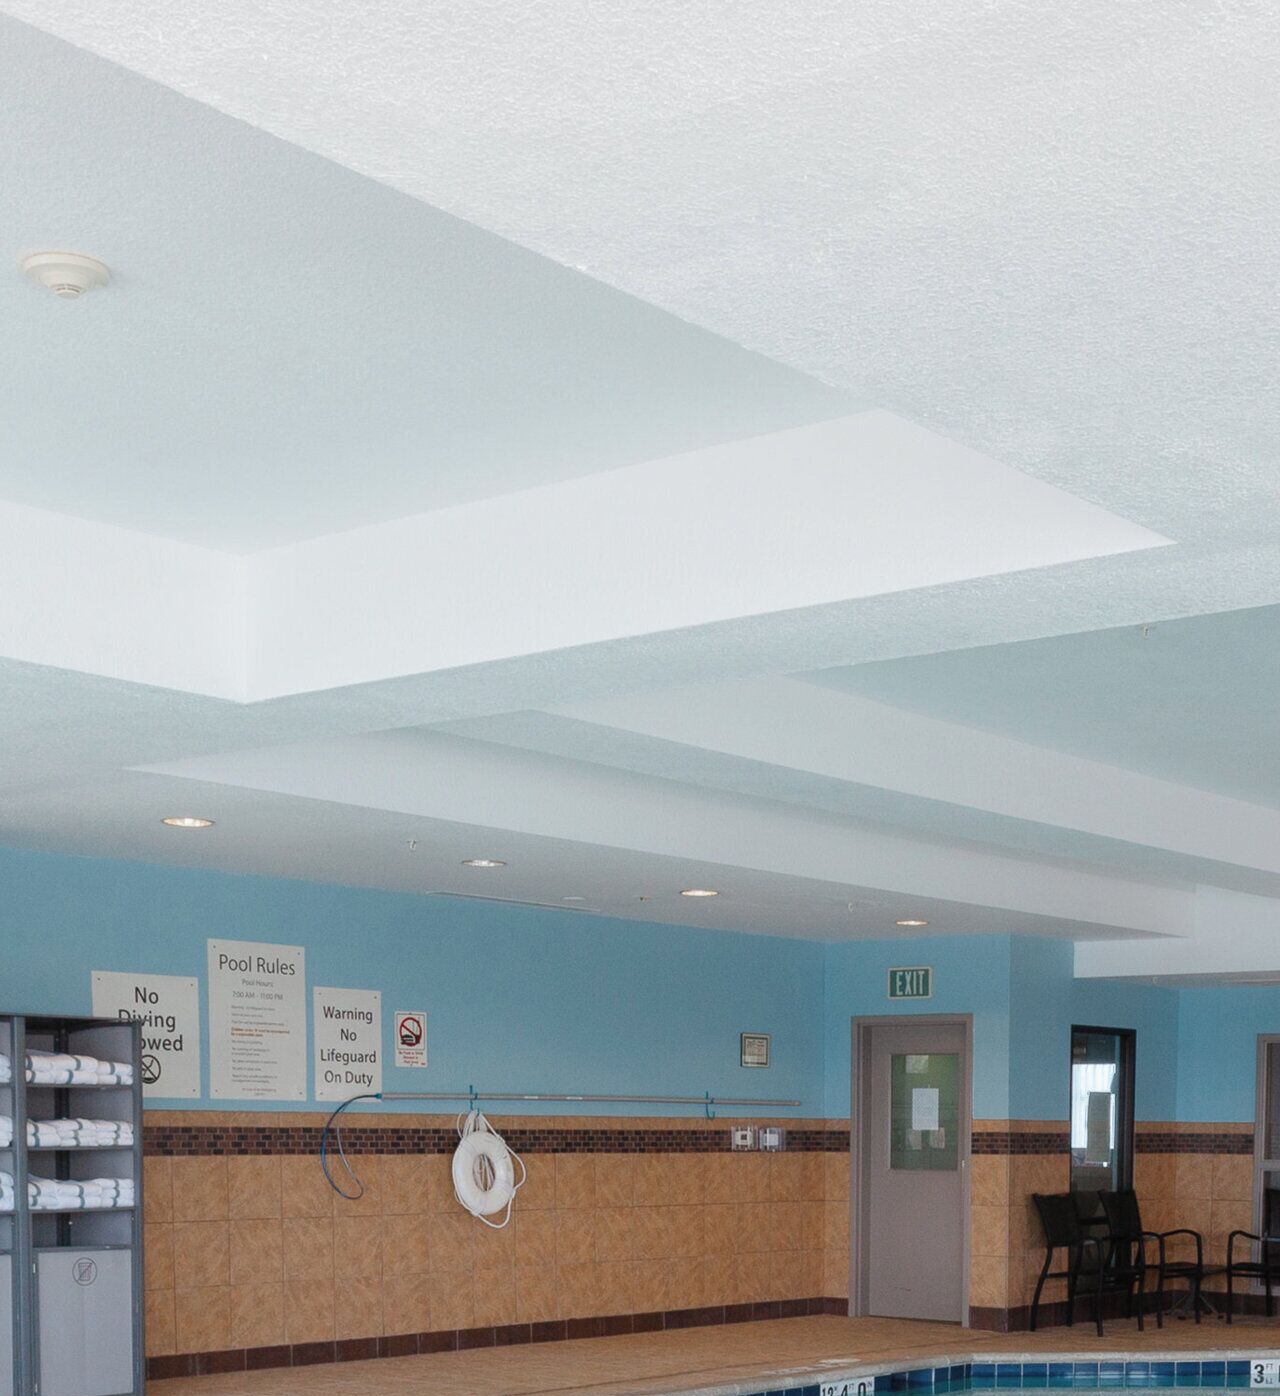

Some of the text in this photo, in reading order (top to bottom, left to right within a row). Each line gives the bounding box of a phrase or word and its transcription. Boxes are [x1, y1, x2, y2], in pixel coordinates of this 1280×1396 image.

[219, 954, 296, 976] Pool Rules
[896, 970, 925, 995] EXIT
[135, 986, 159, 1004] No
[118, 1009, 176, 1032] Diving
[323, 1006, 373, 1024] Warning
[340, 1028, 357, 1041] No
[320, 1048, 376, 1065] Lifeguard
[324, 1070, 373, 1087] On Duty
